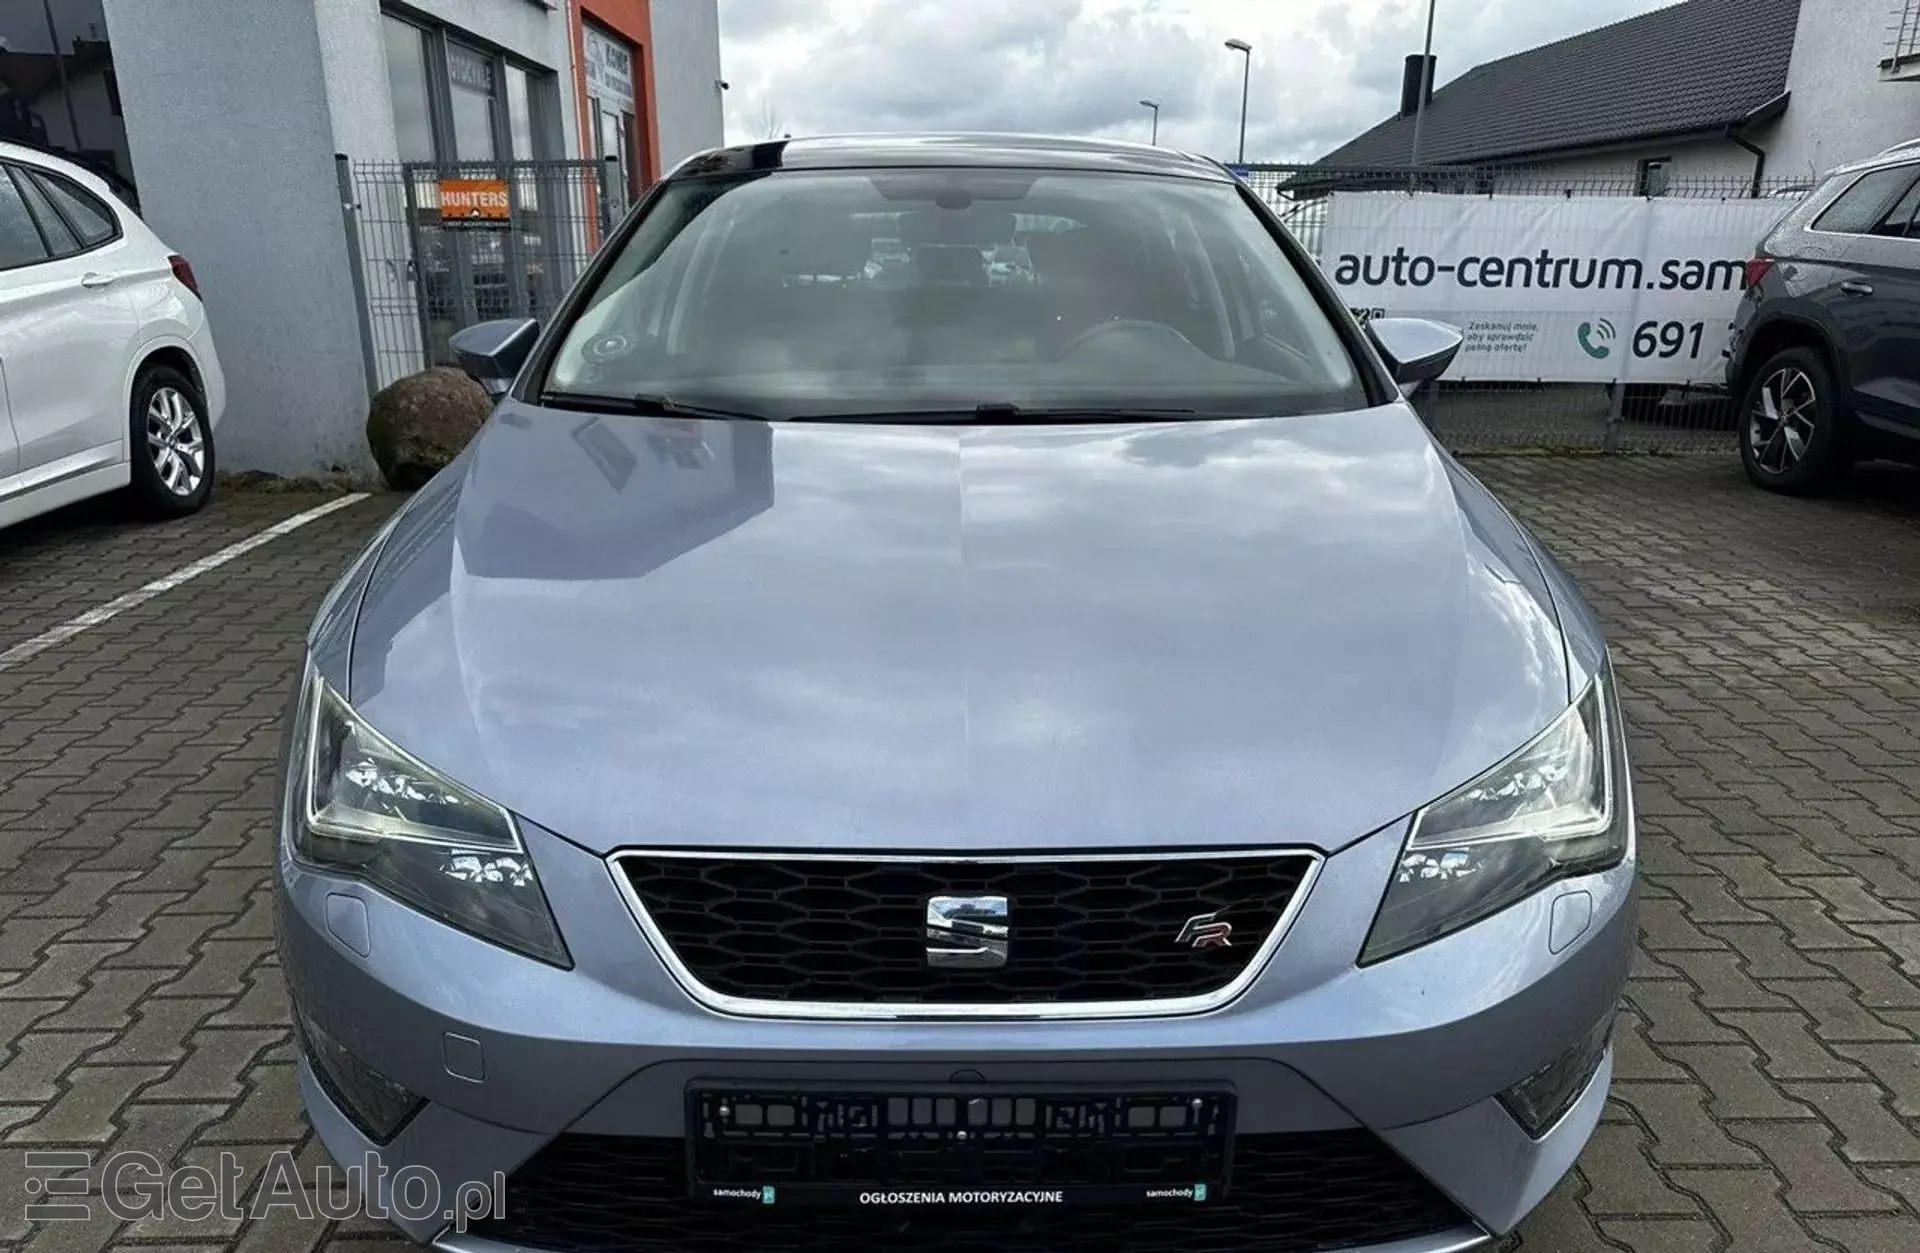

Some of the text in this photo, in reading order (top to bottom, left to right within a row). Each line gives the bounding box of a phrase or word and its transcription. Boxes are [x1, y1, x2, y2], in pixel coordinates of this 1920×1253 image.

[441, 190, 508, 207] HUNTERS
[1468, 320, 1512, 332] Zeskanuj
[1466, 332, 1485, 342] aby
[1633, 320, 1704, 360] 691
[1174, 911, 1233, 948] FR
[859, 1190, 1064, 1204] OGŁOSZENIA MOTORYZACYJNE
[1145, 1187, 1193, 1198] samochody
